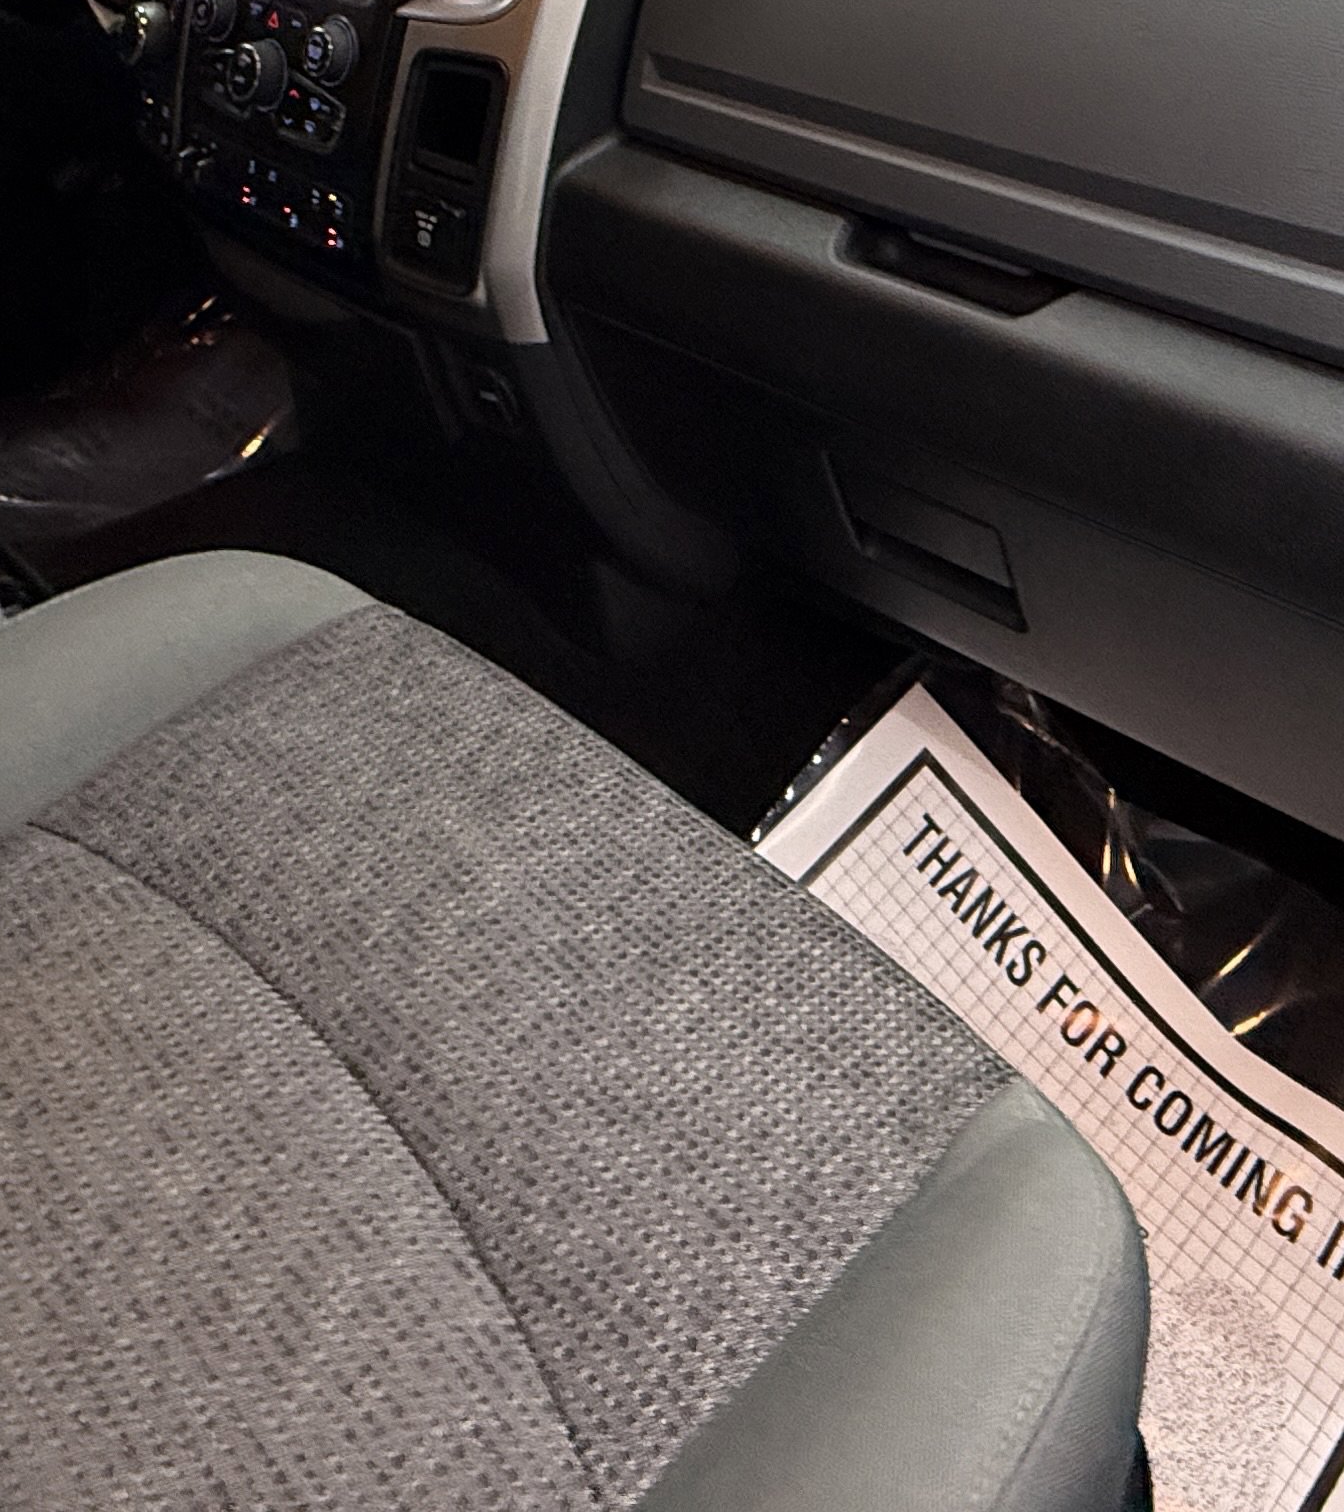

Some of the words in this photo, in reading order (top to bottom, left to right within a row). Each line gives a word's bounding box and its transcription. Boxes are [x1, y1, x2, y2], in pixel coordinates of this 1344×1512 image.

[902, 813, 1047, 988] THANKS
[1036, 974, 1128, 1079] FOR
[1126, 1064, 1314, 1243] COMING
